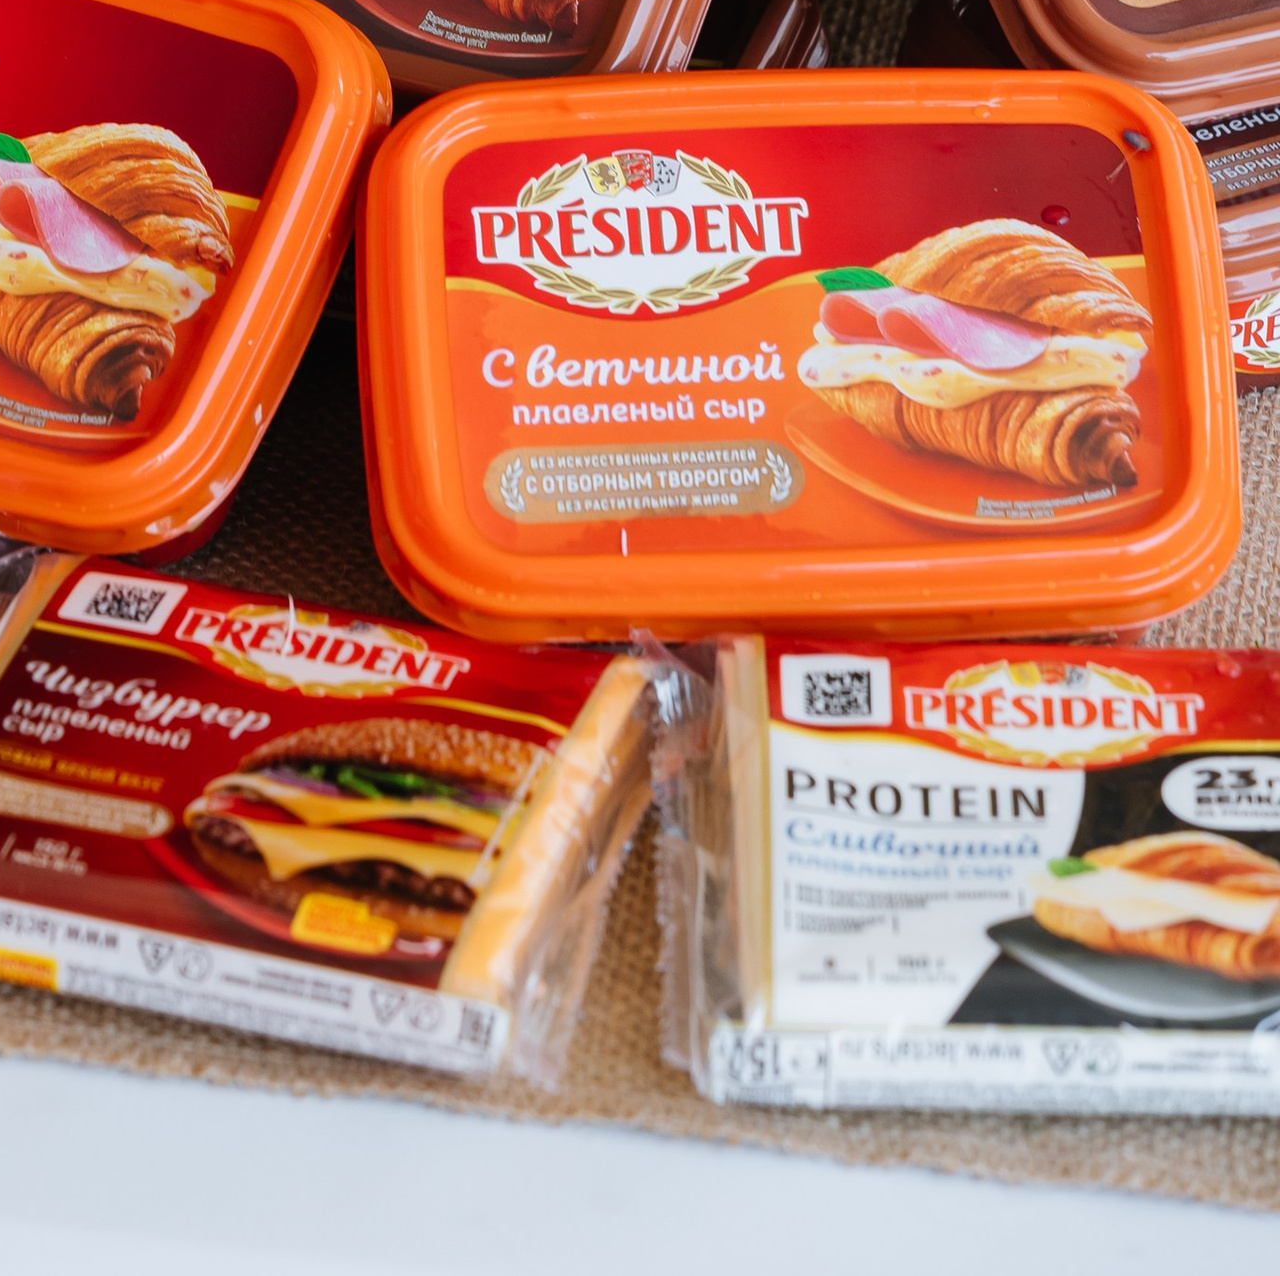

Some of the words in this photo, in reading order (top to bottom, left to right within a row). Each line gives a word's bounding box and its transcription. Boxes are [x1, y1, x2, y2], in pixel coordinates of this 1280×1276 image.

[479, 198, 804, 268] PRÉSIDENT
[482, 348, 515, 388] С
[526, 341, 785, 388] ветчиной
[512, 394, 695, 425] плавленый
[703, 397, 766, 424] сыр
[530, 456, 555, 470] БЕЗ
[558, 451, 669, 468] ИСКУССТВЕННЫХ
[672, 447, 757, 463] КРАСИТЕЛЕЙ
[525, 475, 538, 494] С
[542, 470, 653, 494] ОТБОРНЫМ
[557, 499, 581, 513] БЕЗ
[586, 495, 687, 512] РАСТИТЕЛЬНЫХ
[691, 492, 739, 508] ЖИРОВ
[181, 612, 462, 687] PRÉSIDENT
[25, 660, 271, 740] Чизбургер
[912, 688, 1198, 734] PRÉSIDENT
[2, 714, 65, 744] сыр
[12, 697, 192, 750] плавленый
[785, 768, 1046, 818] PROTEIN
[1195, 769, 1257, 789] 23
[1197, 794, 1280, 805] БЕЛК
[785, 818, 1040, 858] Сливочный
